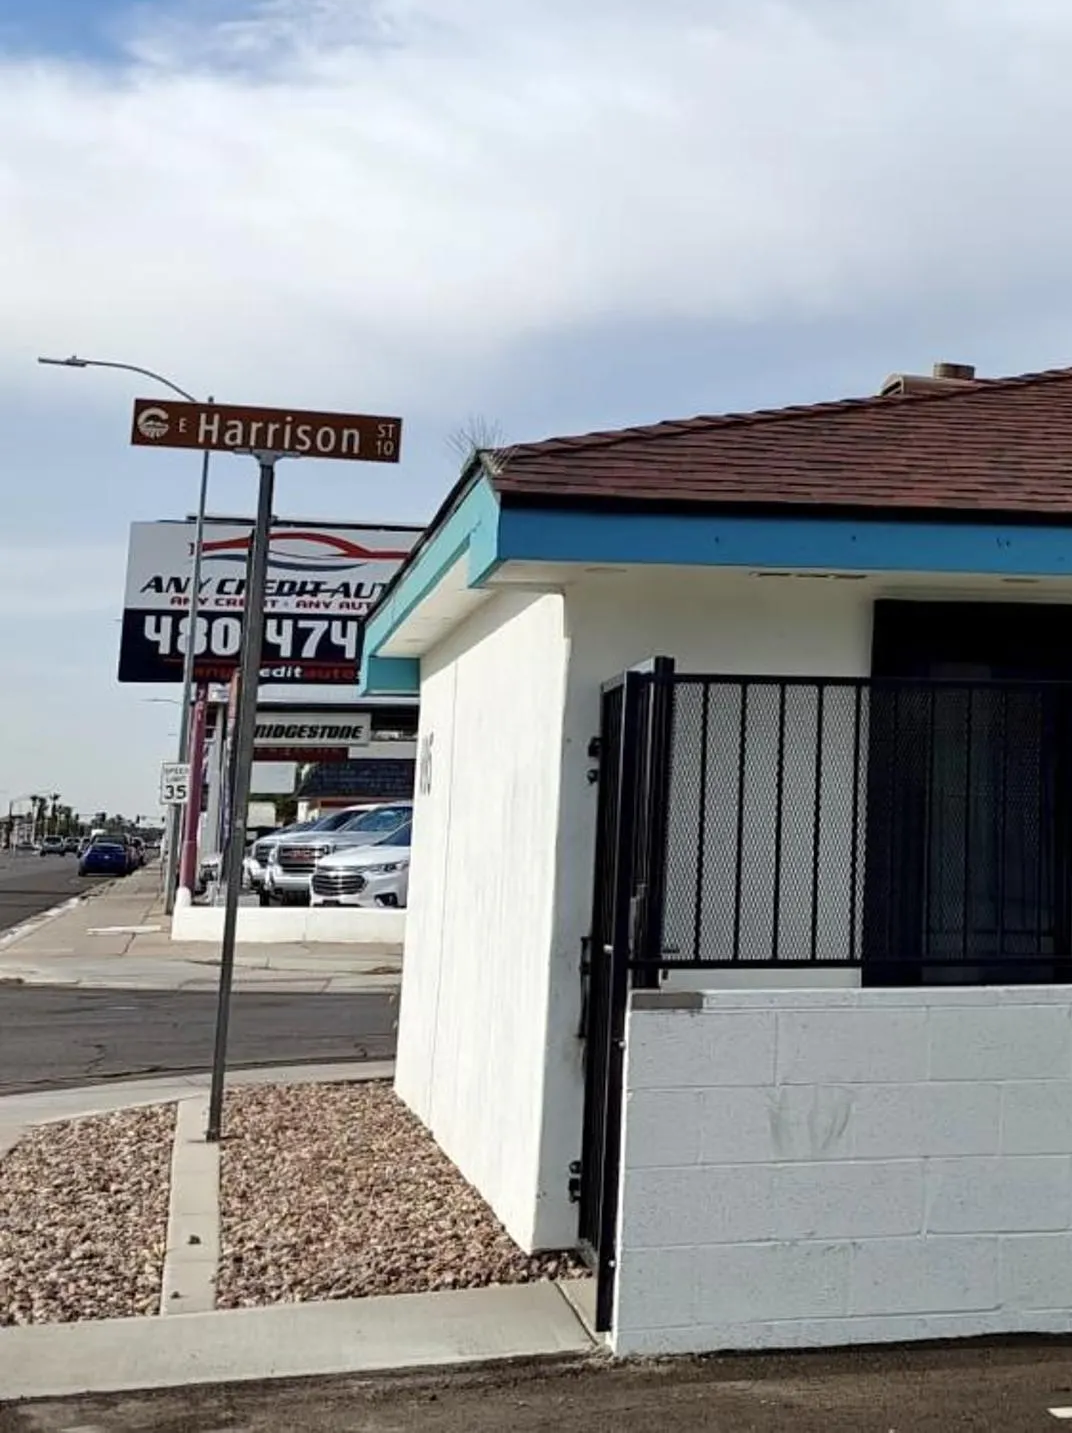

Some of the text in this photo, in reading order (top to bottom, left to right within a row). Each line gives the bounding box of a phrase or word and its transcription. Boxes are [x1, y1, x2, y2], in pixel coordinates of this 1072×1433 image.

[178, 412, 396, 454] E Harrison ST
[376, 440, 394, 456] 10
[140, 575, 212, 594] ANY
[296, 599, 332, 609] ANY
[144, 615, 242, 656] 480
[254, 724, 364, 739] RIDGESTONE
[164, 785, 187, 799] 35
